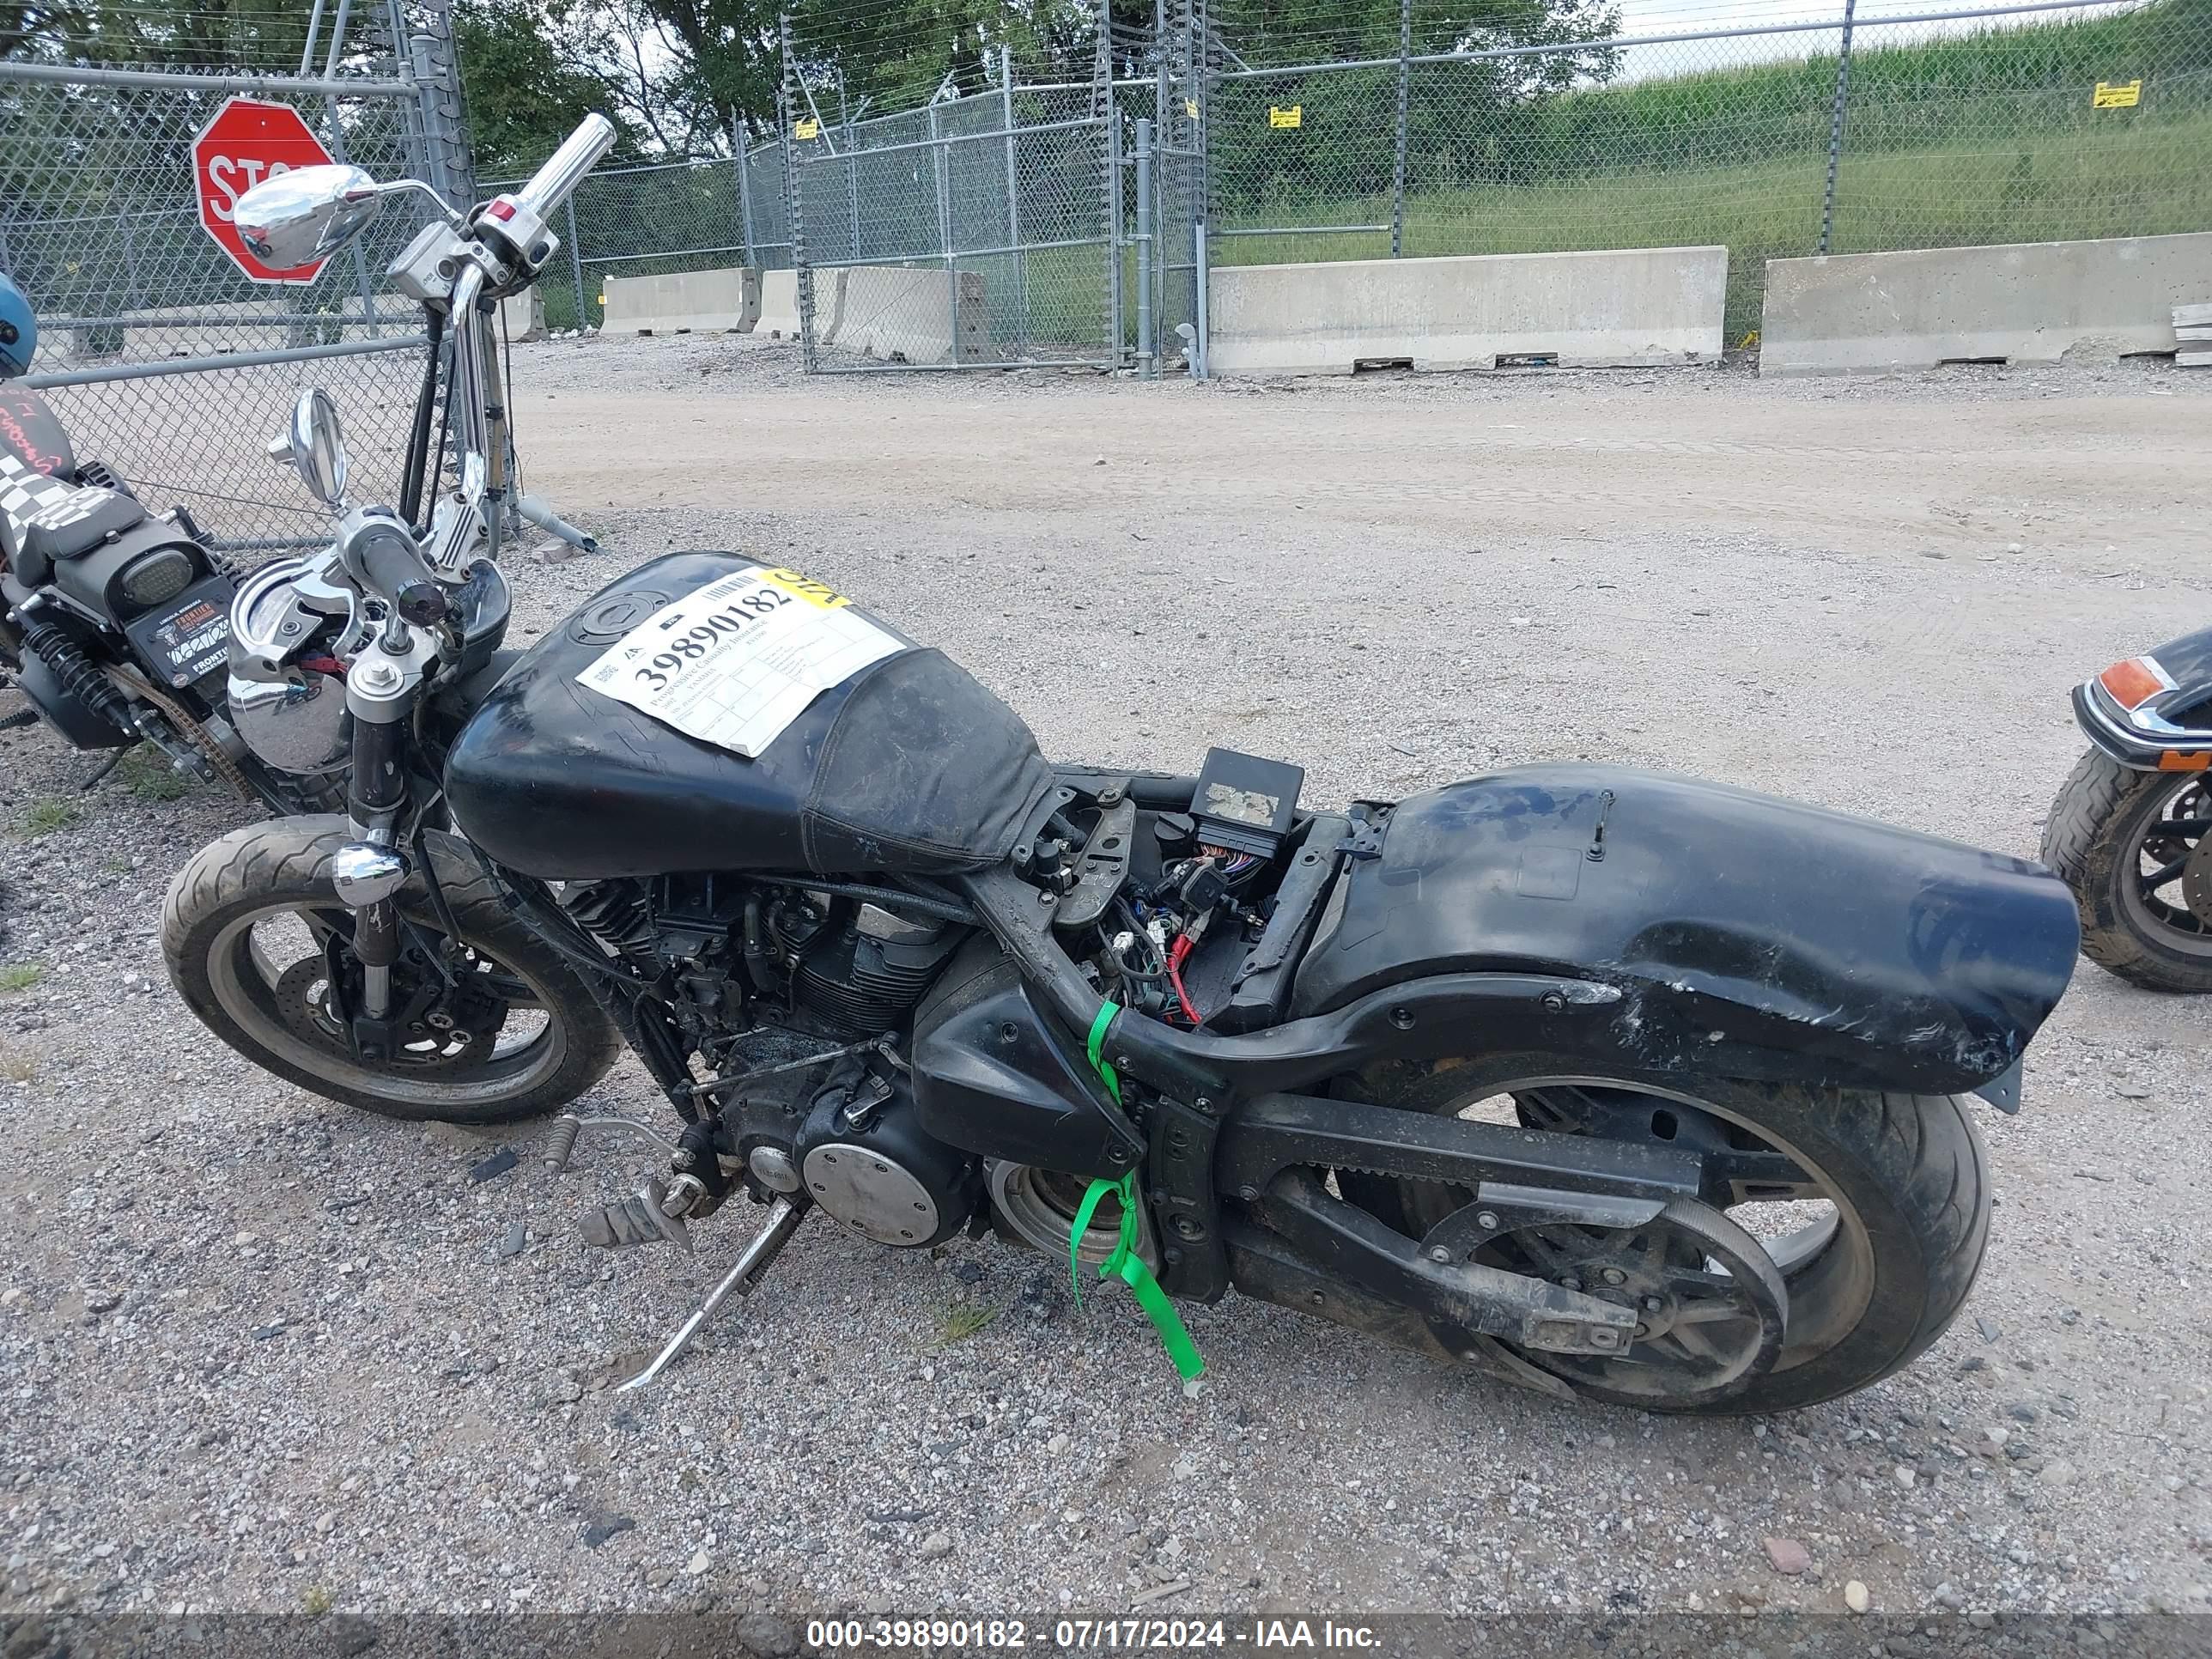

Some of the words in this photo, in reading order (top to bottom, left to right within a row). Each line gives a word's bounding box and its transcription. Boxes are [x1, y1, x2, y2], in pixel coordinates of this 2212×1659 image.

[175, 603, 211, 625] FRONTIER
[635, 589, 793, 691] 39890182
[650, 667, 697, 706] Progressive
[696, 642, 732, 670] Casualty
[730, 619, 769, 645] Insurance
